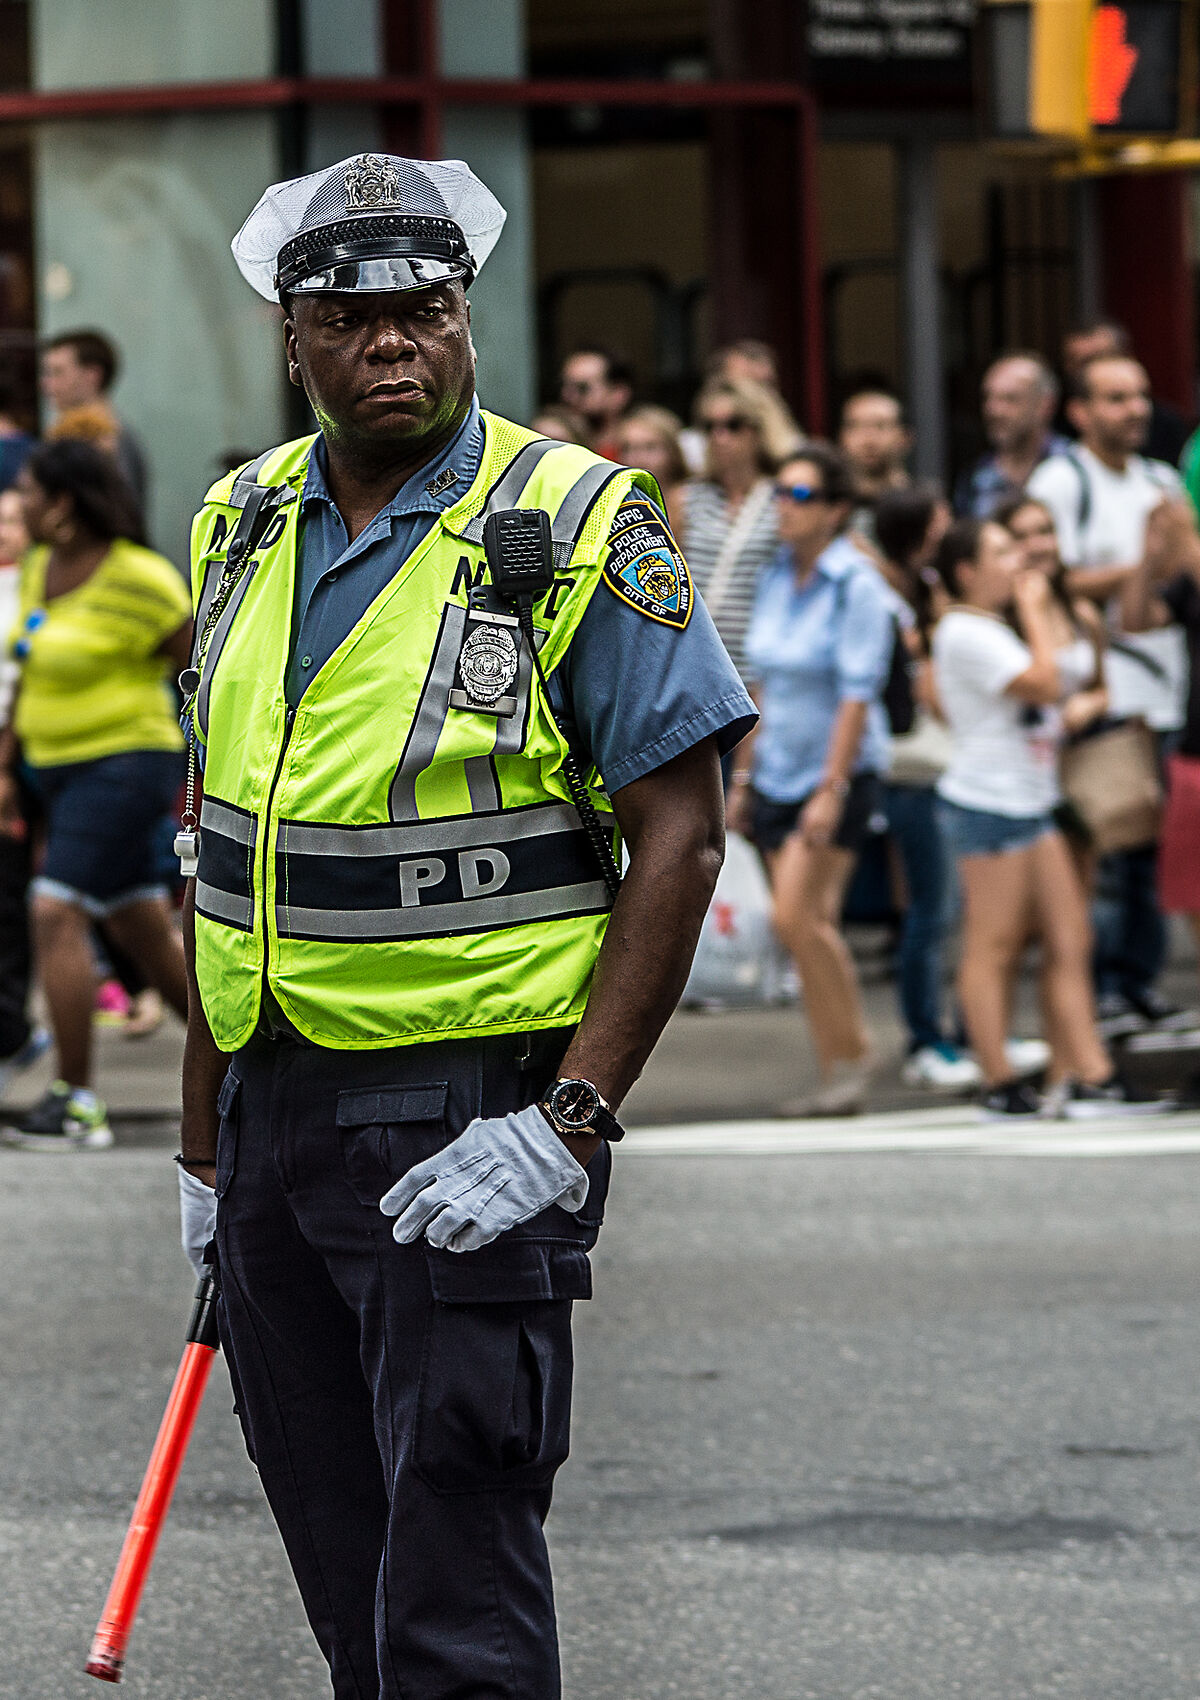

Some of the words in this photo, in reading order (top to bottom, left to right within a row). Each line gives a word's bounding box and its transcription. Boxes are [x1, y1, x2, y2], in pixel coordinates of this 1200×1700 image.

[206, 513, 287, 555] ND
[613, 526, 652, 553] POLICE
[609, 535, 668, 575] DEPARTMENT
[672, 553, 688, 582] YORK
[449, 555, 577, 620] ND
[623, 585, 649, 606] CITY
[680, 585, 689, 611] NEW
[651, 604, 667, 616] OF
